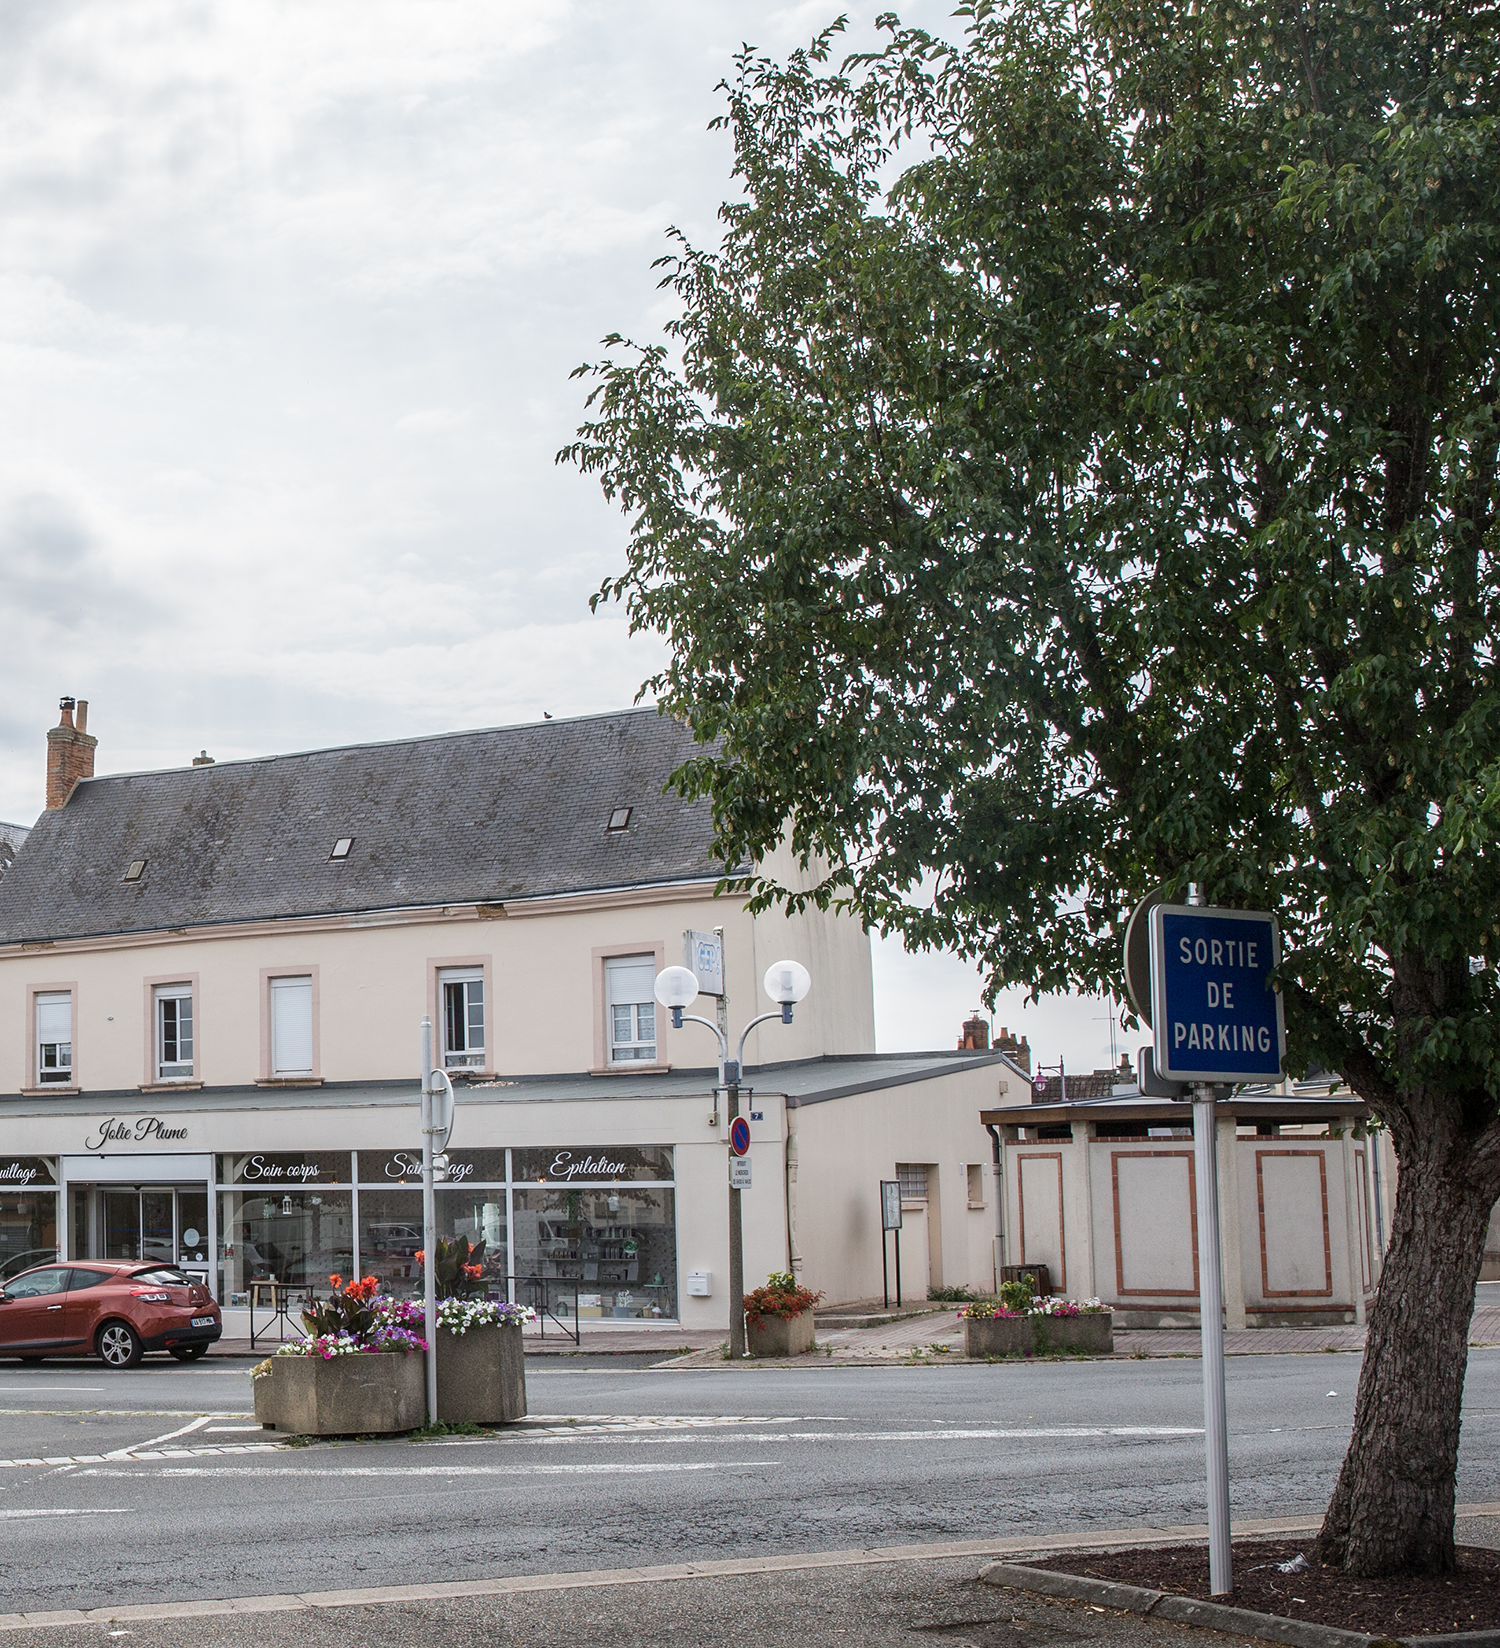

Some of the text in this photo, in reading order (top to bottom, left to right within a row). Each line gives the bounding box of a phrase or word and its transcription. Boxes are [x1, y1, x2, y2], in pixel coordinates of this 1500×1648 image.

[1179, 936, 1259, 968] SORTIE
[1206, 981, 1235, 1009] DE
[1173, 1021, 1271, 1053] PARKING
[85, 1117, 188, 1150] Jolie Plume
[243, 1155, 320, 1183] Soin corps
[550, 1151, 626, 1182] Epilation
